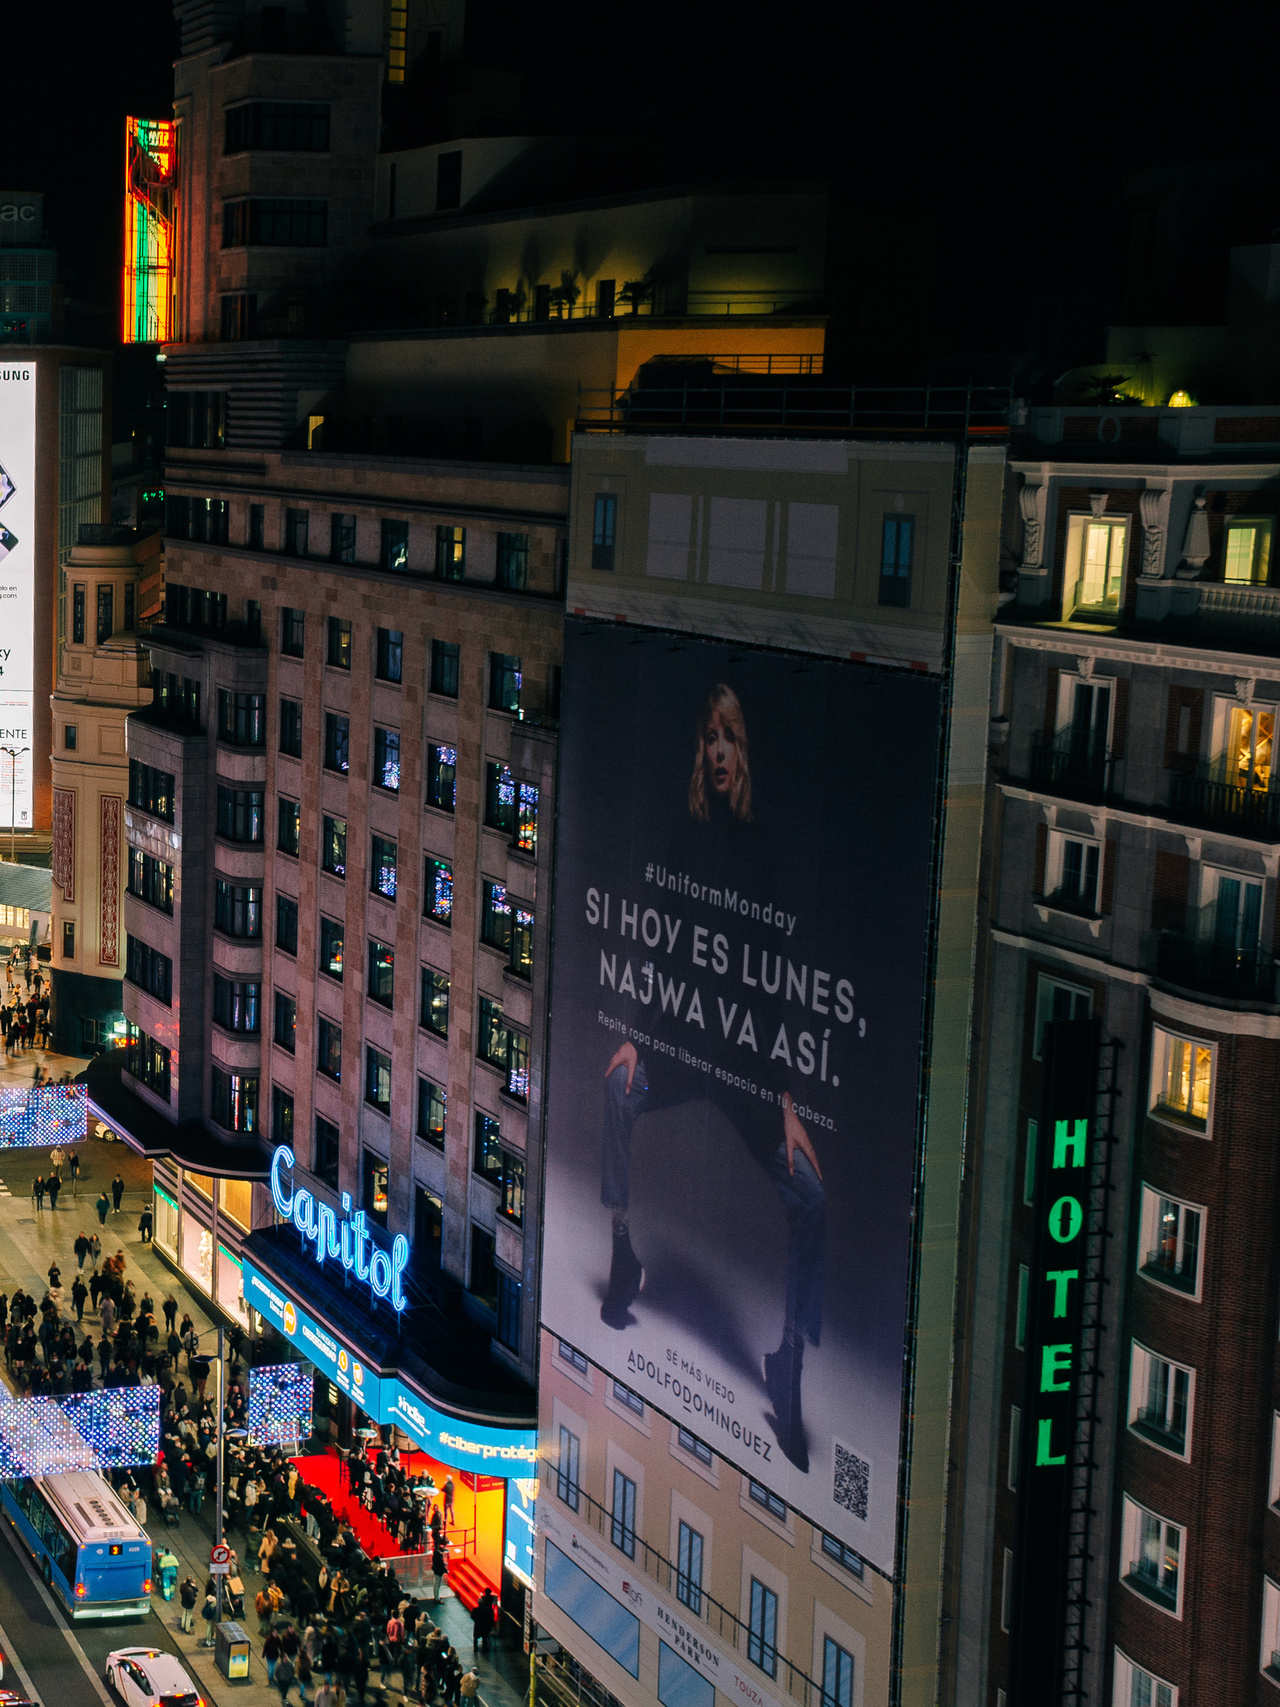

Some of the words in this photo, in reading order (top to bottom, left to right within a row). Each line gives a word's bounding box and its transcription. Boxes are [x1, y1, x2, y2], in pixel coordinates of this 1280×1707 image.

[645, 862, 796, 936] #UniformMonday
[585, 887, 610, 929] SI
[620, 899, 682, 954] HOY
[692, 925, 729, 974] ES
[742, 943, 866, 1038] LUNES,
[599, 949, 706, 1030] NAJWA
[718, 996, 758, 1052] VA
[770, 1022, 840, 1087] ASÍ.
[598, 1010, 627, 1034] Repite
[629, 1027, 651, 1046] ropa
[653, 1039, 676, 1057] para
[678, 1046, 713, 1073] liberar
[715, 1067, 757, 1094] espacio
[760, 1088, 774, 1102] en
[777, 1094, 788, 1109] tu
[791, 1102, 837, 1132] cabeza.
[271, 1144, 409, 1312] Capitol
[1035, 1119, 1089, 1467] HOTEL
[627, 1349, 772, 1463] ADOLFODOMINGUEZ
[666, 1348, 678, 1366] SÉ
[681, 1359, 702, 1382] MÁS
[705, 1374, 736, 1404] VIEJO
[112, 1545, 119, 1555] 3
[657, 1607, 719, 1667] HENDERSON
[674, 1634, 701, 1665] PARK
[734, 1675, 763, 1707] TOUZA
